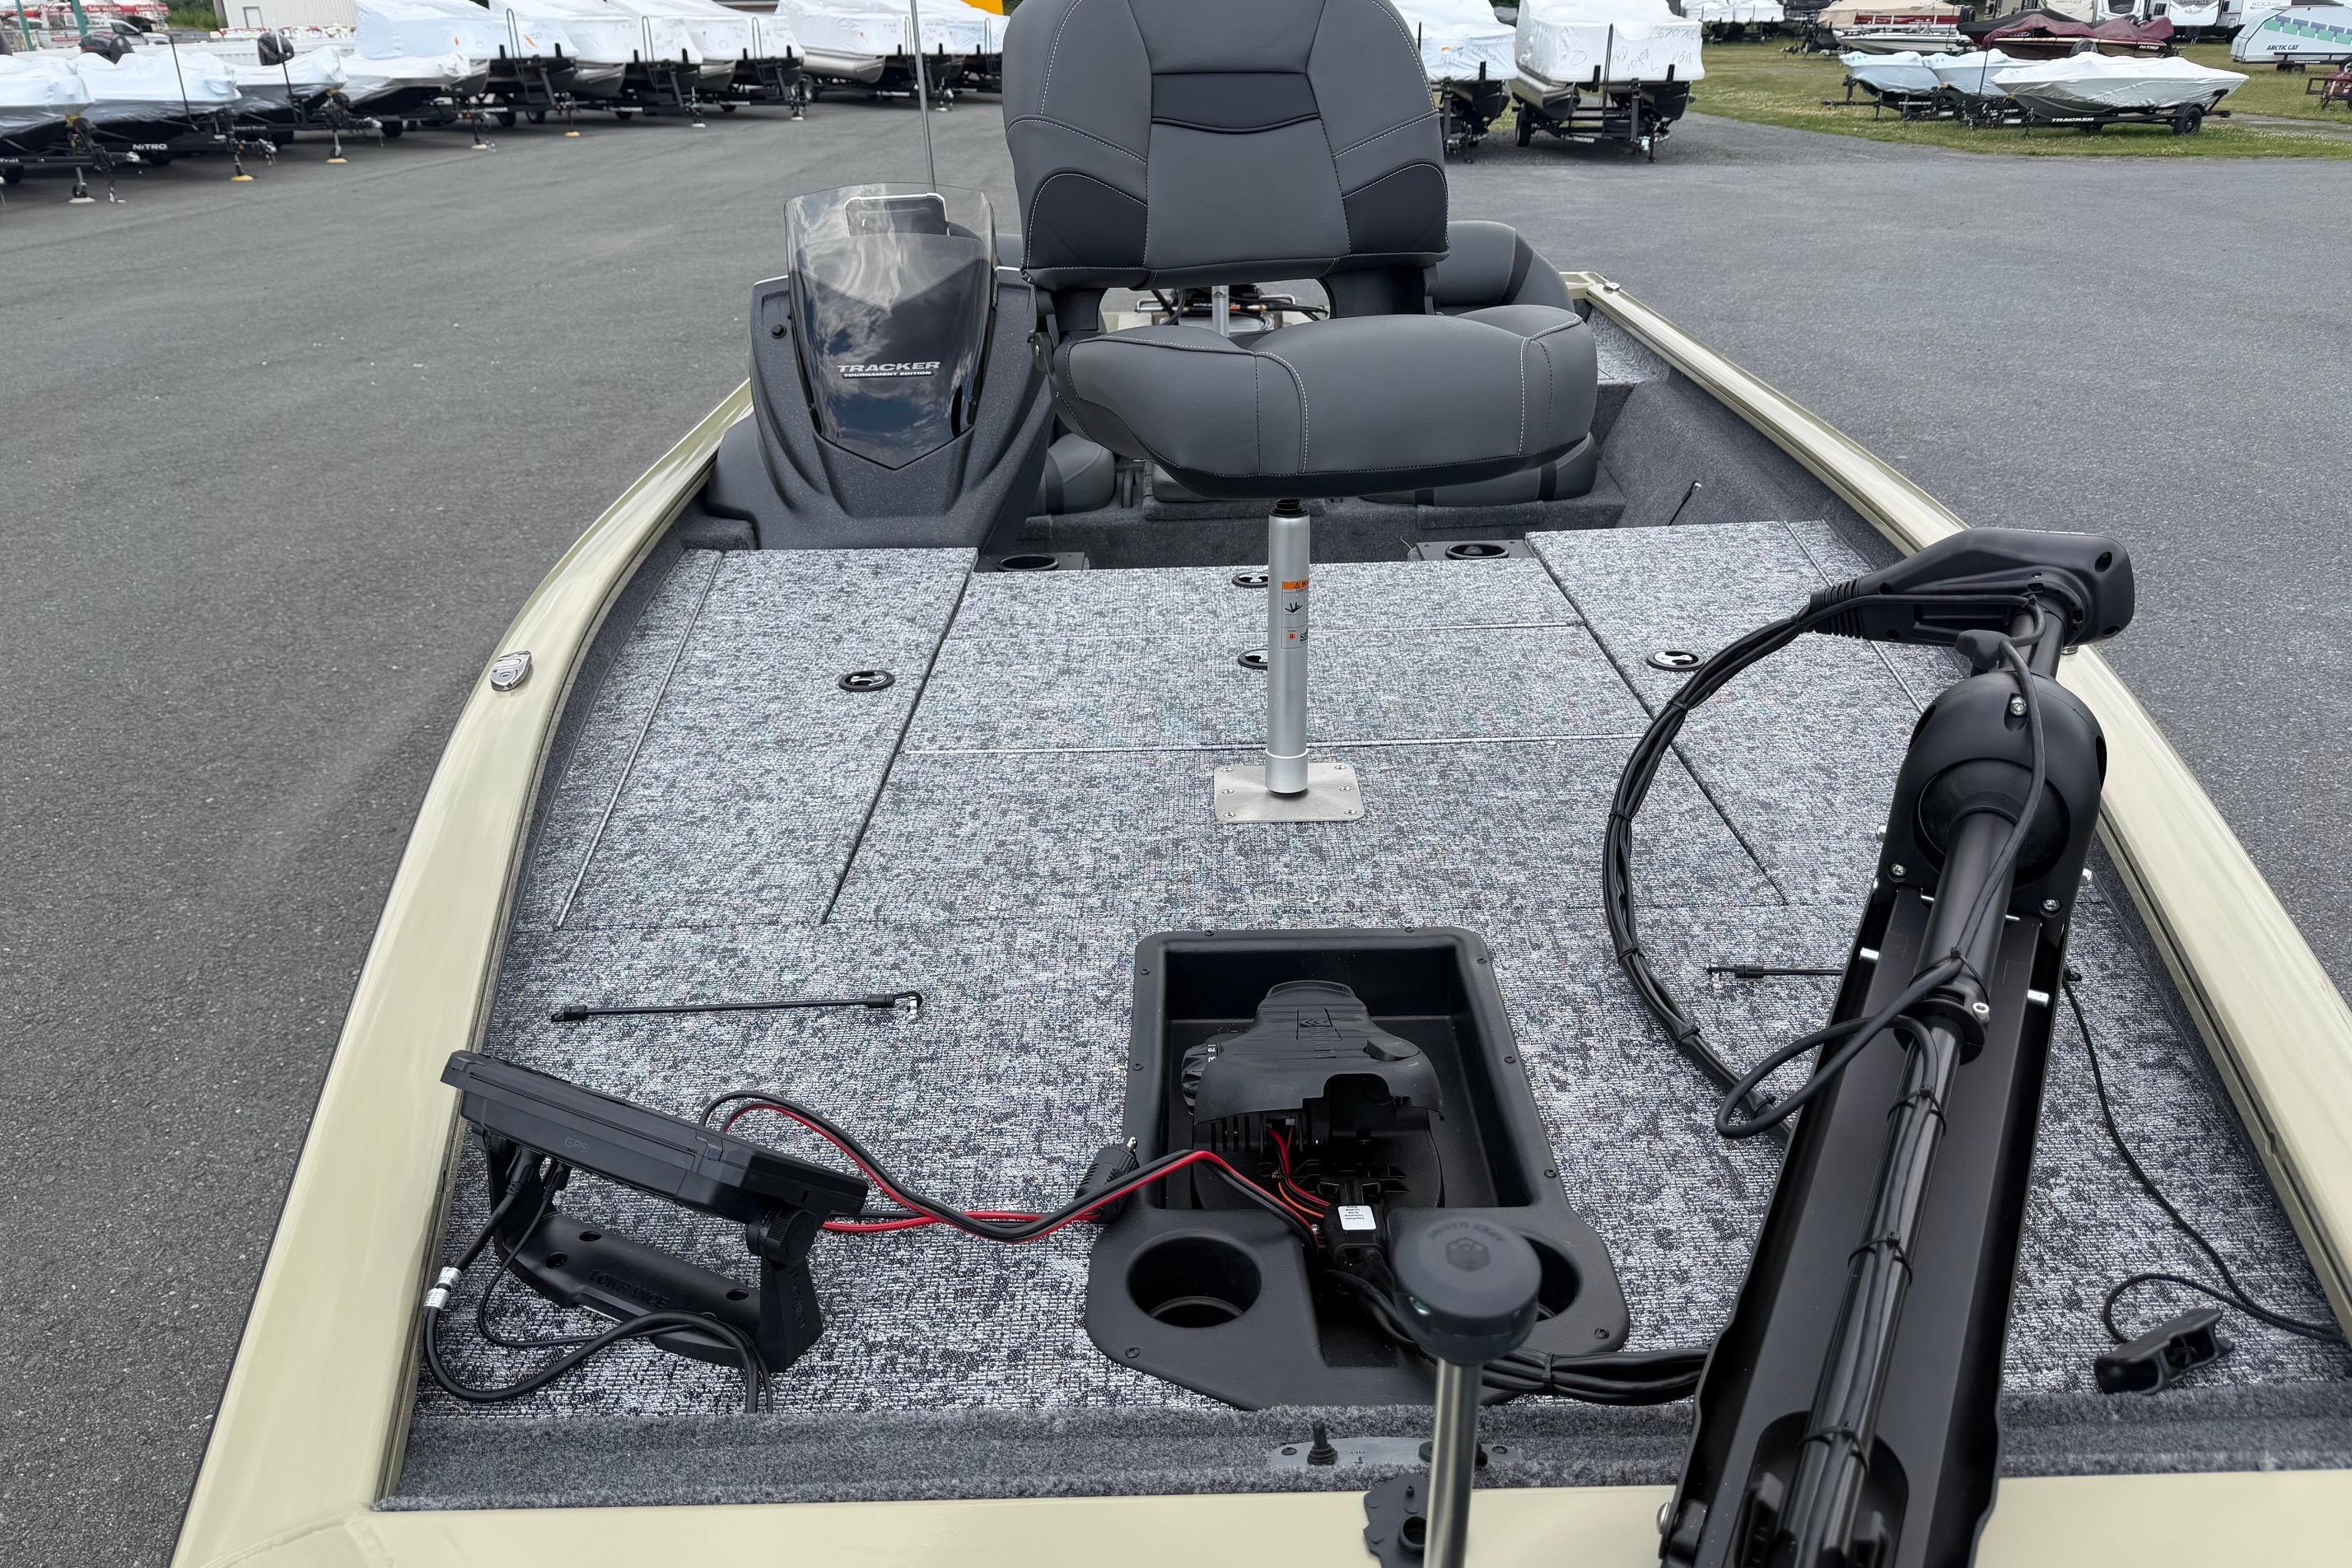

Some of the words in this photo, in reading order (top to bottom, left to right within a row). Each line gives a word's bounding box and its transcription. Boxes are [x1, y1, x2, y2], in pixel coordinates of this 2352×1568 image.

[837, 362, 940, 372] TRACKER
[565, 1136, 588, 1153] GPS
[589, 1269, 670, 1309] LOWRANCE
